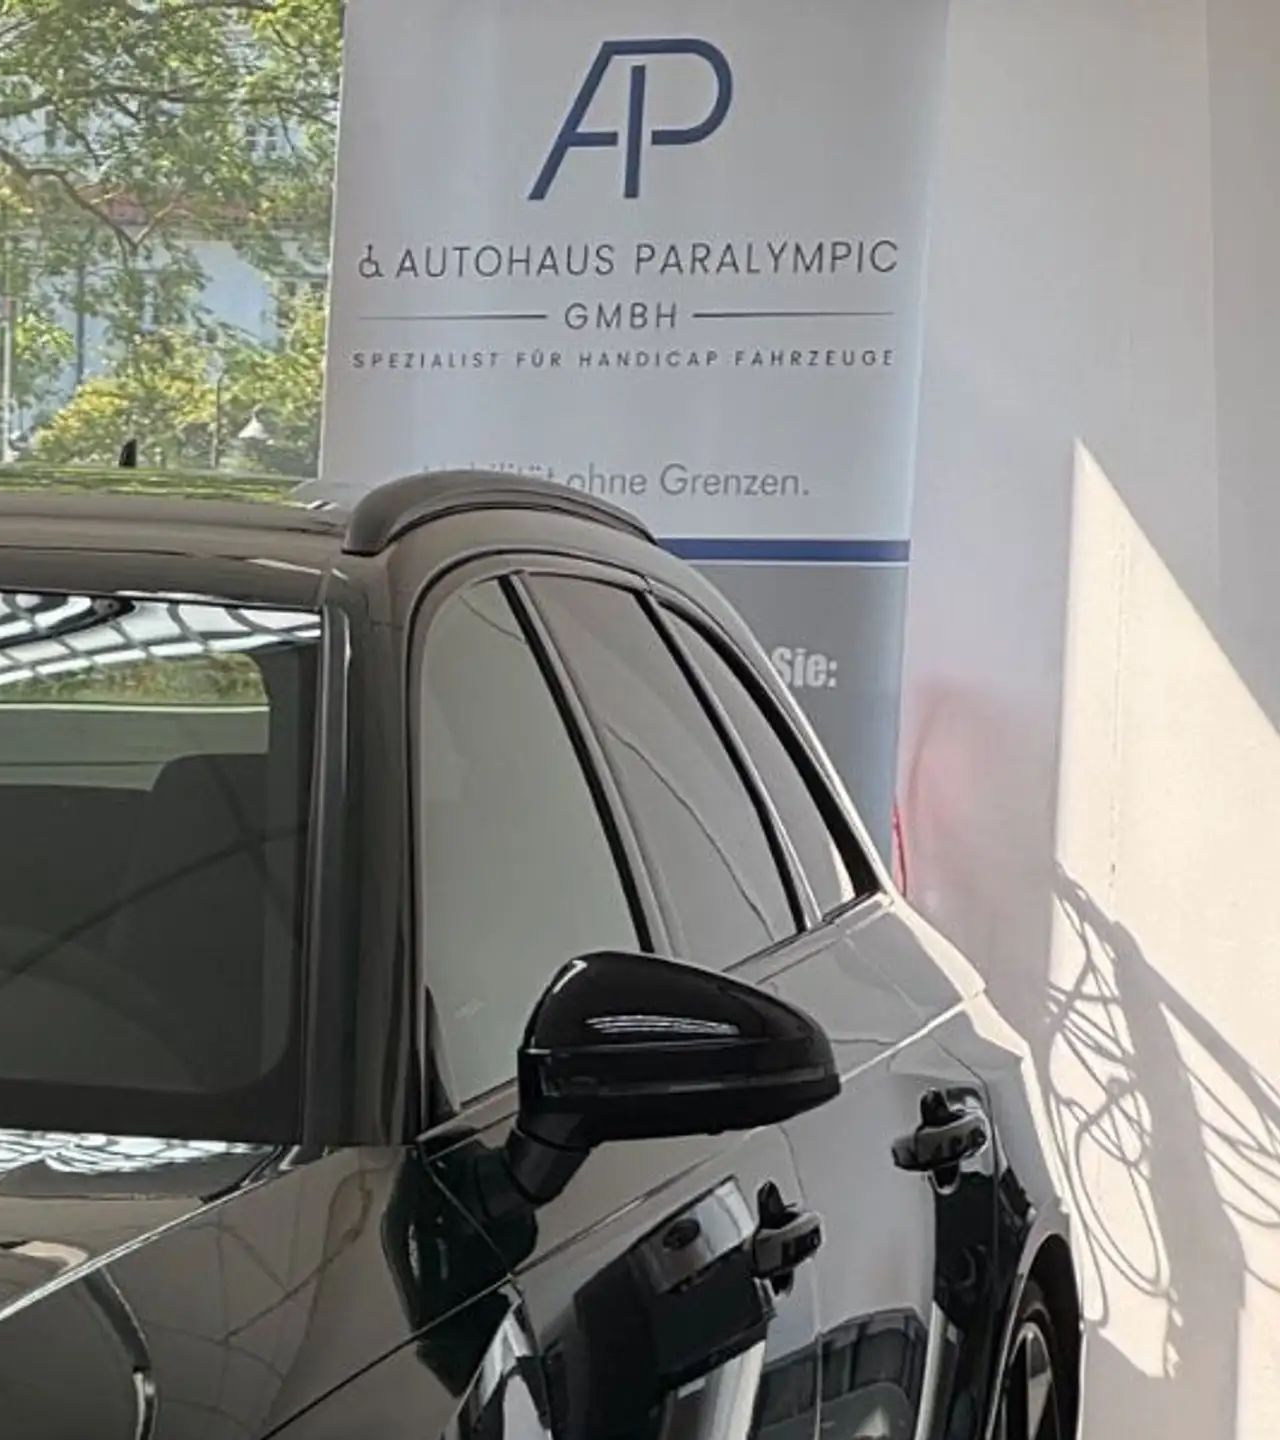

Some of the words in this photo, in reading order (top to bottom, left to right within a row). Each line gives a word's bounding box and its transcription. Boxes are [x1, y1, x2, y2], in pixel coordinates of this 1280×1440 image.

[526, 38, 734, 202] AP
[395, 243, 615, 279] AUTOHAUS
[635, 240, 899, 276] PARALYMPIC
[565, 302, 677, 330] GMBH
[353, 352, 500, 369] SPEZIALIST
[516, 348, 561, 368] FÜR
[579, 350, 718, 368] HANDICAP
[735, 349, 893, 367] FAHRZEUGE
[567, 462, 647, 496] ohne
[659, 462, 809, 497] Grenzen.
[771, 646, 838, 688] Sie:
